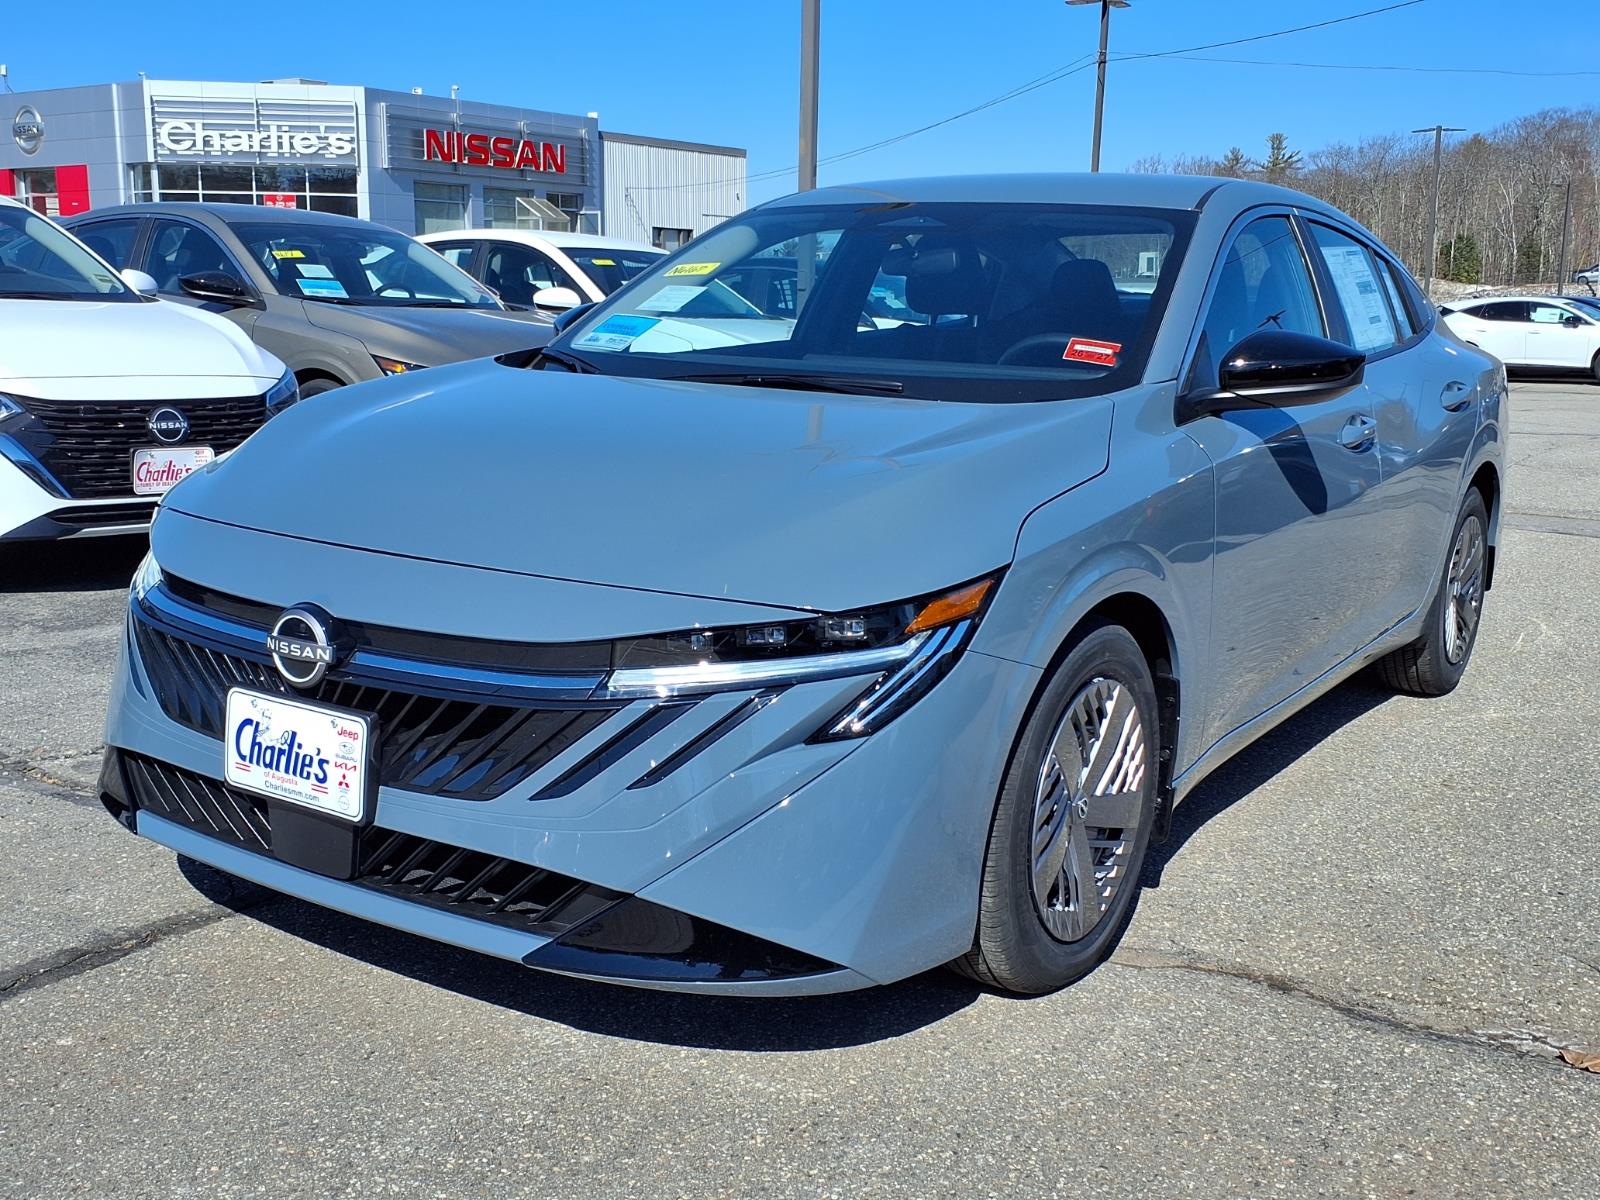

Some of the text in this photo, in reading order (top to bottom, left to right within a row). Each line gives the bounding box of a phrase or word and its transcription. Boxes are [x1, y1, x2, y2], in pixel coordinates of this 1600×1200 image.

[159, 121, 352, 155] Charlie's
[424, 128, 566, 173] NISSAN
[1097, 353, 1111, 361] 27
[149, 421, 187, 429] NISSAN
[267, 636, 330, 661] NISSAN
[337, 726, 359, 741] Jeep
[235, 718, 330, 784] Charlie's
[265, 780, 320, 802] Charliesmm.com
